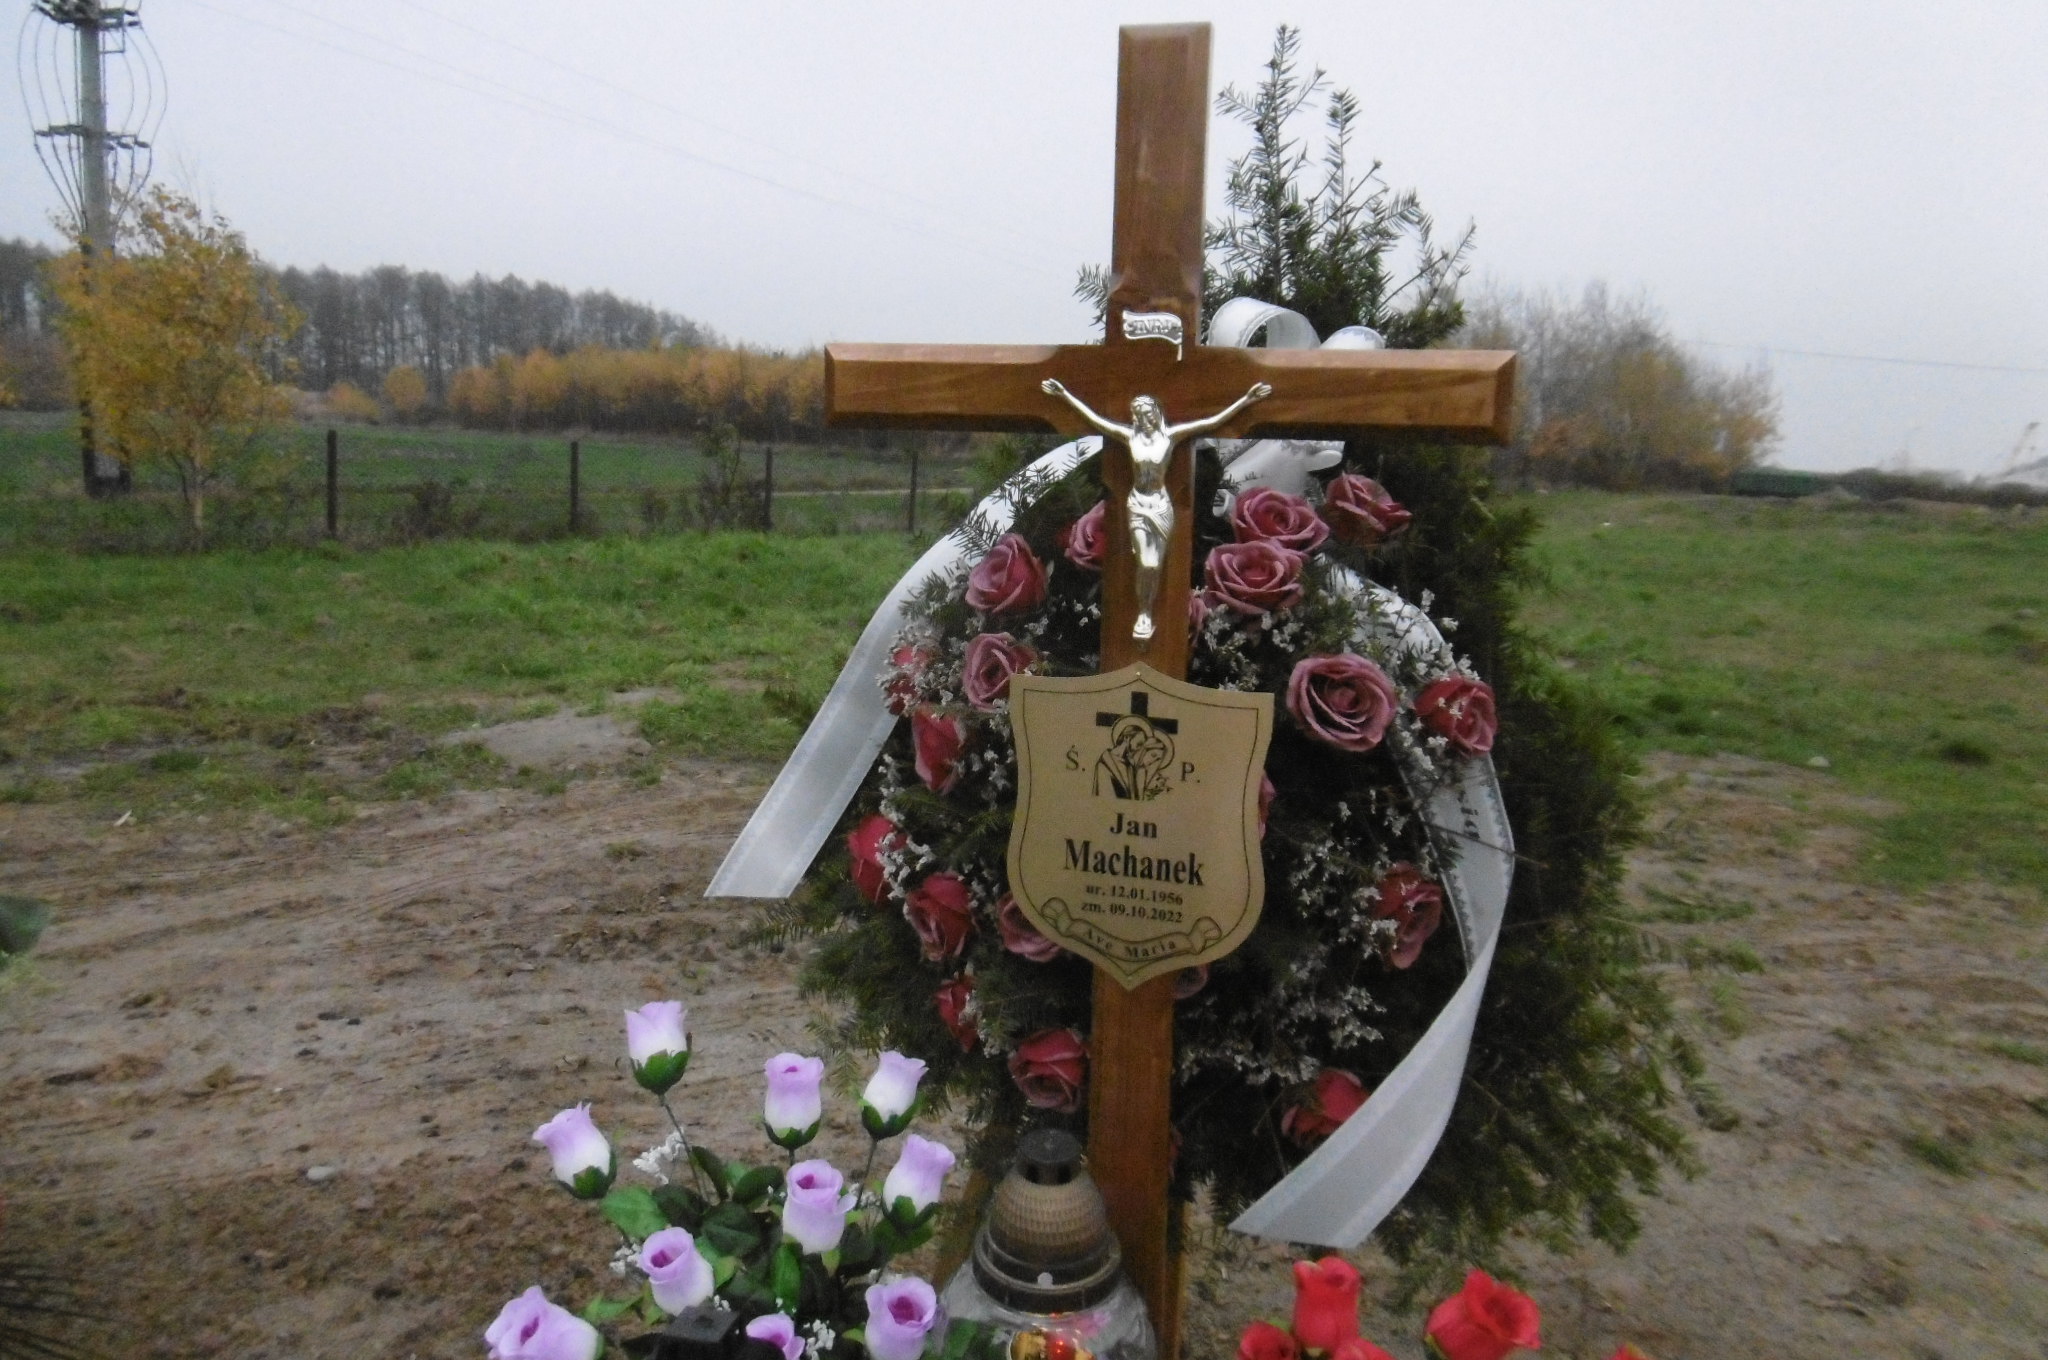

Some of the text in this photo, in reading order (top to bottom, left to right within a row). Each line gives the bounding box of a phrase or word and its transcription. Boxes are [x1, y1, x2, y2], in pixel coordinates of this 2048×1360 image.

[1065, 744, 1201, 784] Ś. P.
[1110, 813, 1158, 838] Jan
[1064, 838, 1204, 886] Machanek
[1085, 885, 1183, 905] ur. 12.01.1956
[1081, 902, 1183, 923] zm. 09.10.2022
[1084, 928, 1176, 957] Ave Maria
